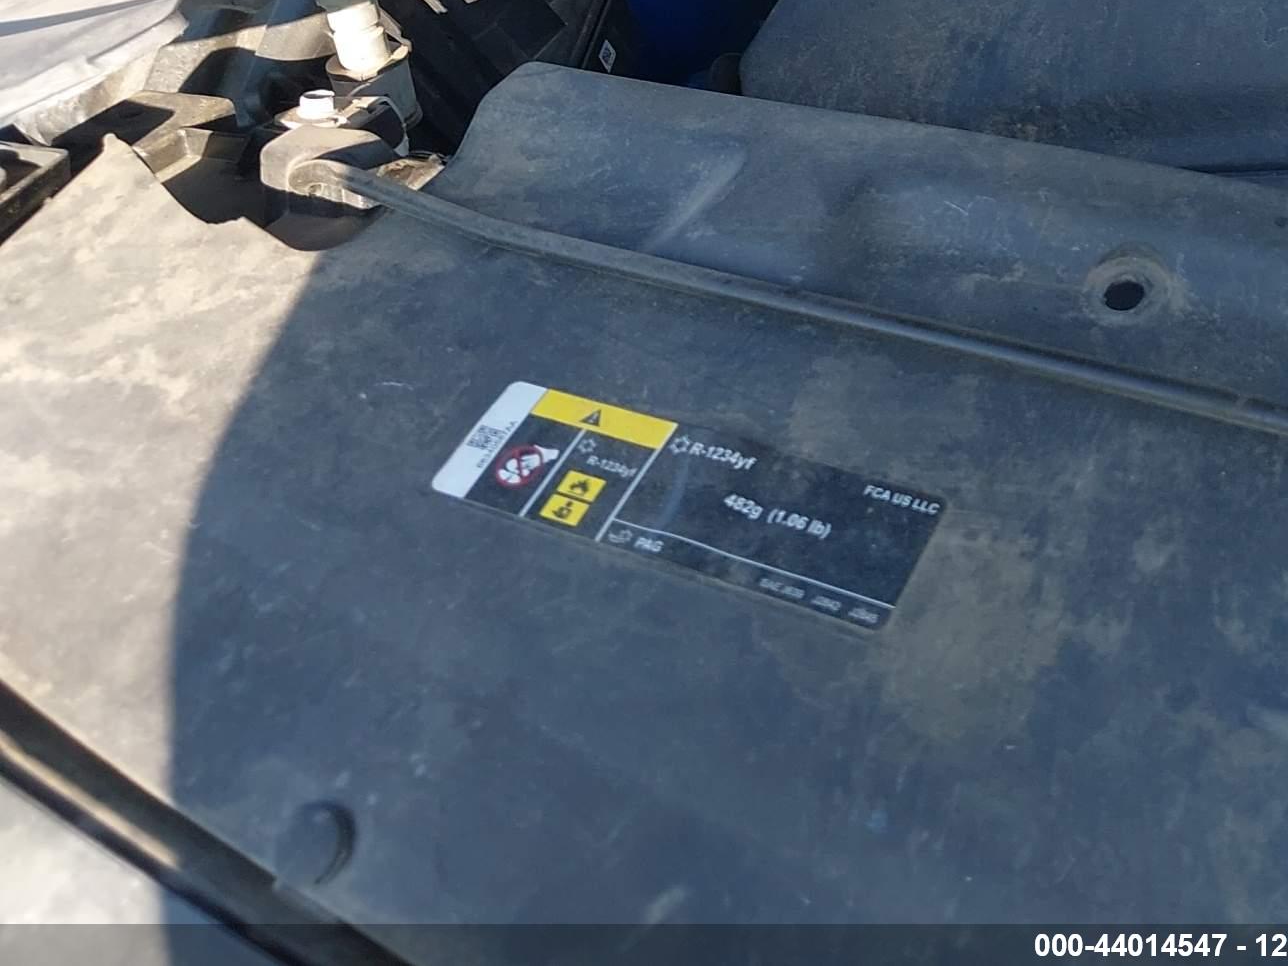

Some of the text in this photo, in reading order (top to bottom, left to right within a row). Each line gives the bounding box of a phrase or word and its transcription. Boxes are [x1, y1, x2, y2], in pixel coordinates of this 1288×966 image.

[688, 441, 758, 470] R-1234yf
[863, 484, 941, 516] FCA US LLC
[723, 493, 832, 540] 482g (1.06 lb)
[634, 536, 665, 553] PAG
